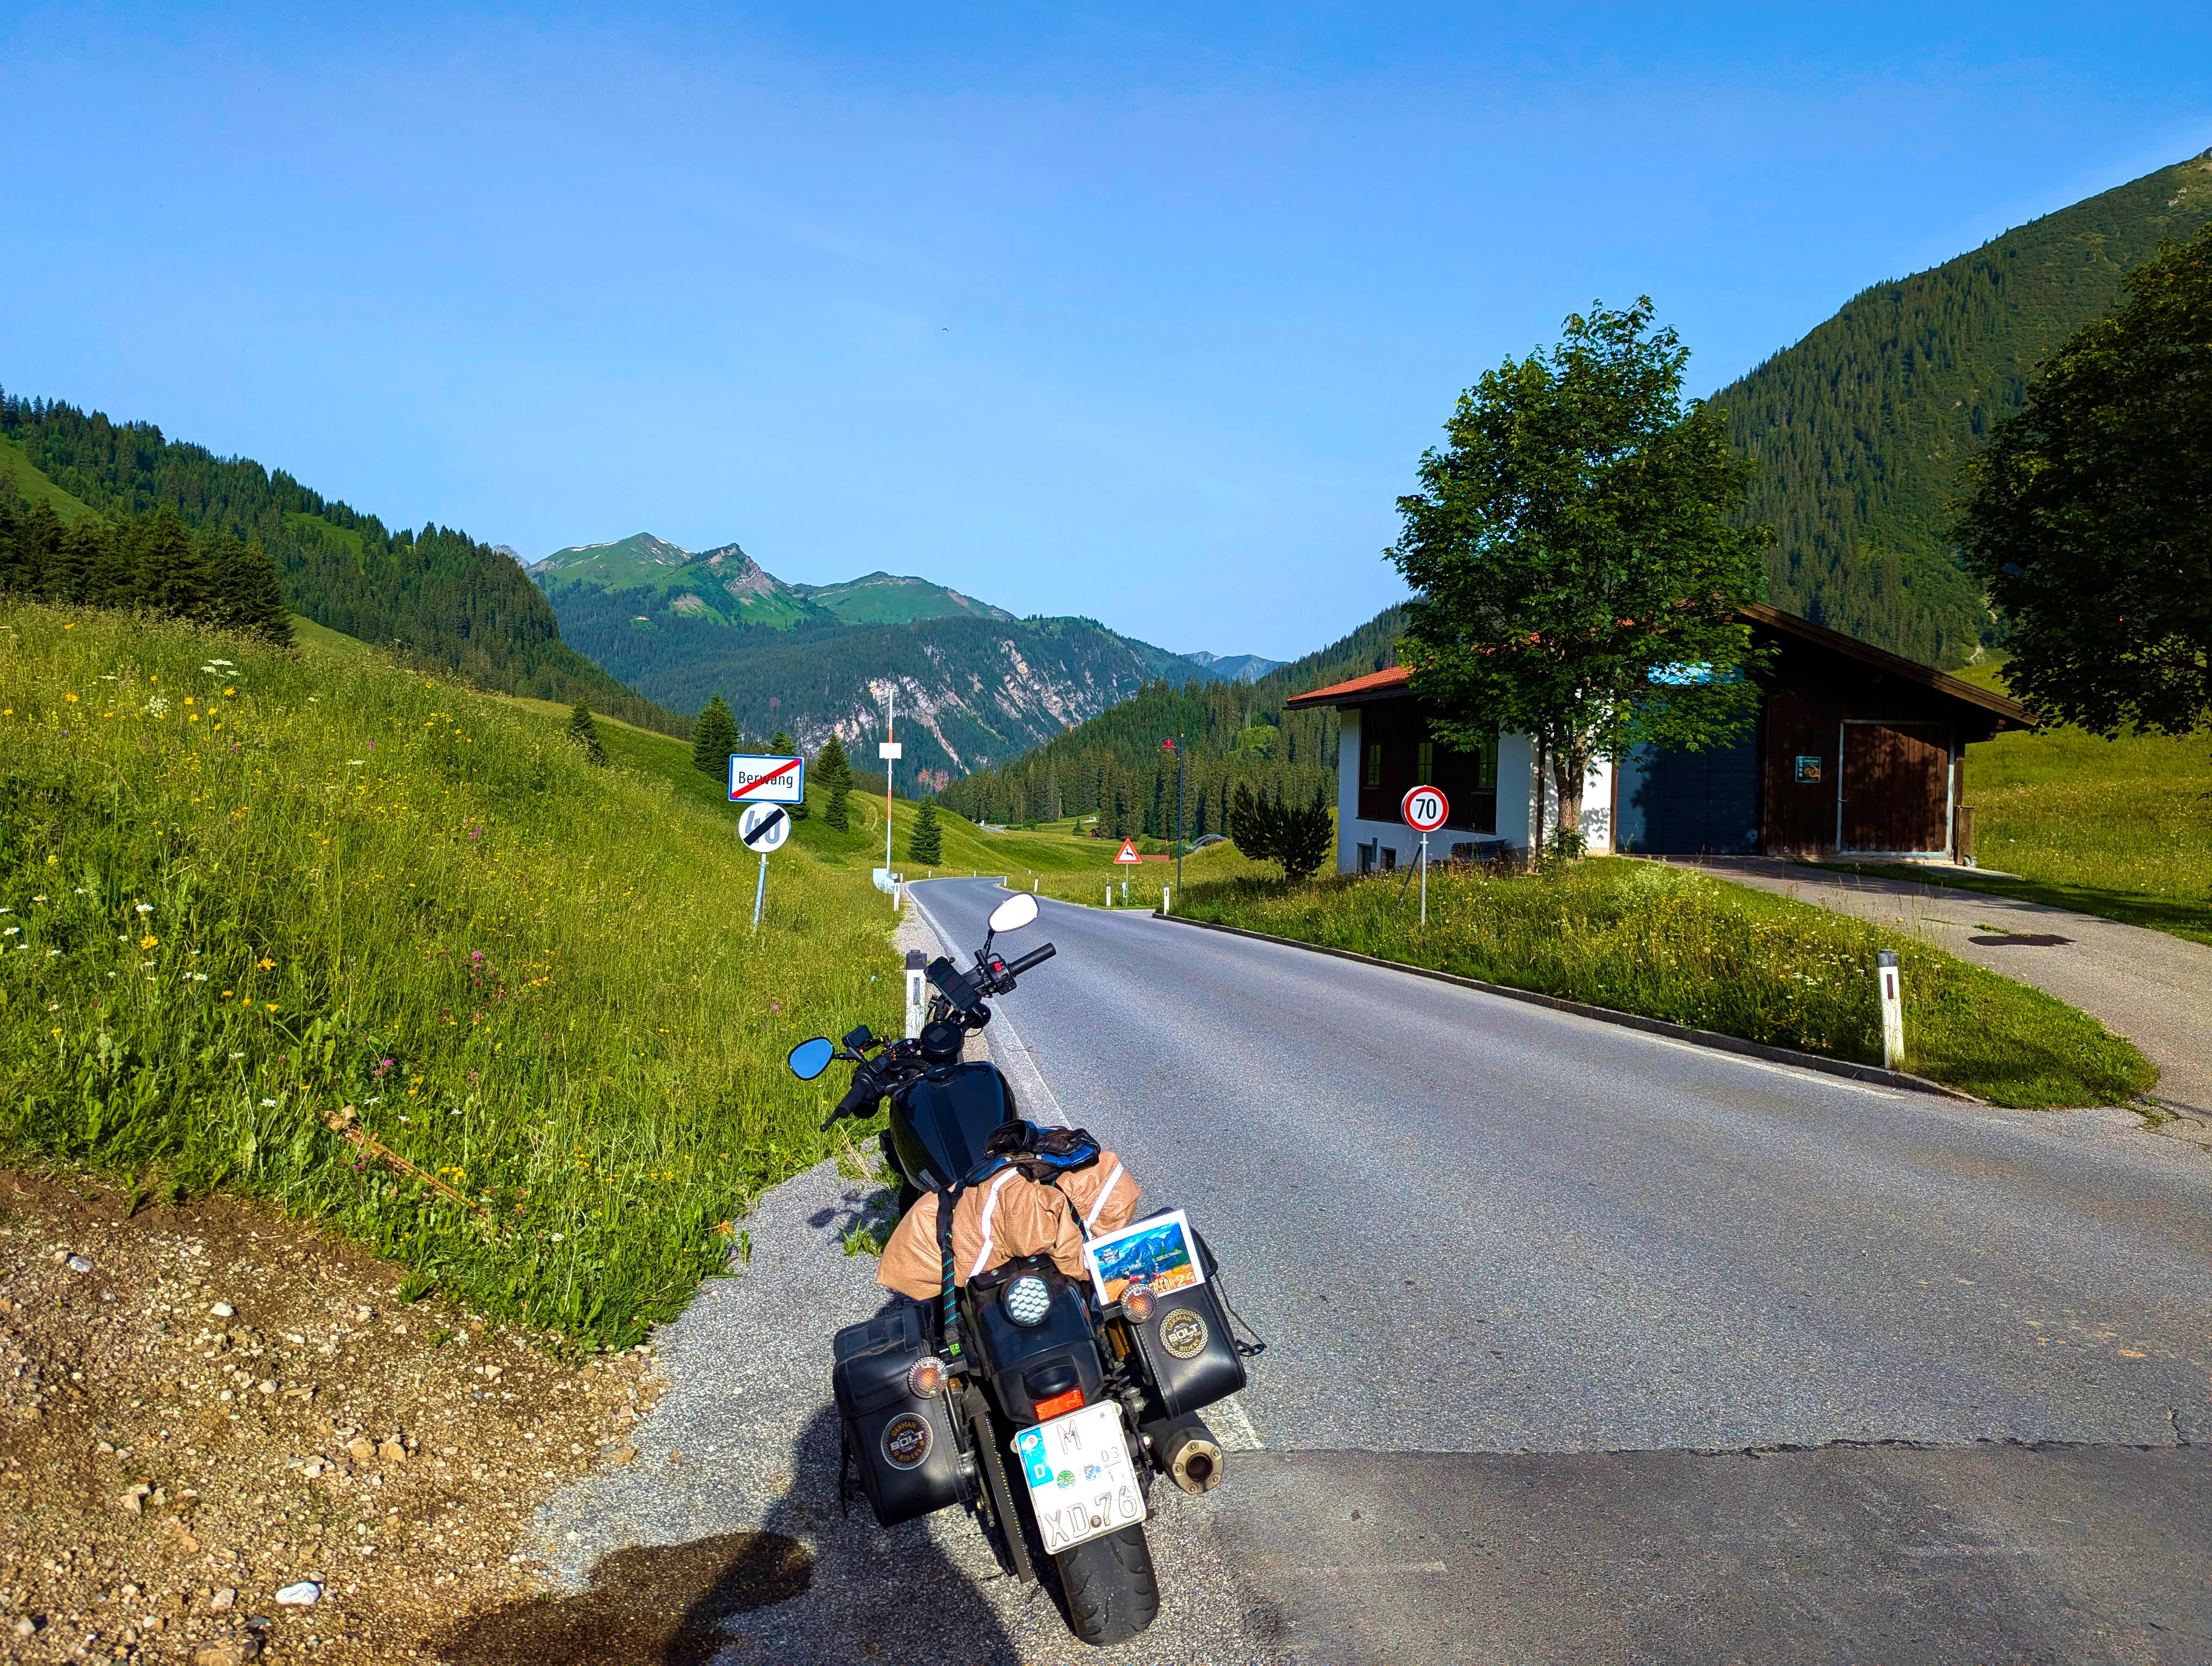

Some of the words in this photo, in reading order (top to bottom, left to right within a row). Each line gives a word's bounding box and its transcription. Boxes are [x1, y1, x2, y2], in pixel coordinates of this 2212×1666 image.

[738, 771, 793, 789] Berwang
[744, 810, 781, 844] 40
[1168, 1323, 1198, 1343] BOLT
[1179, 1338, 1200, 1351] RIDERS
[1416, 1341, 1437, 1362] 70
[890, 1430, 924, 1451] BOLT
[1057, 1419, 1082, 1454] M
[898, 1448, 922, 1461] RIDERS
[1033, 1464, 1046, 1479] D
[1044, 1502, 1090, 1547] XD
[1094, 1485, 1137, 1527] 76
